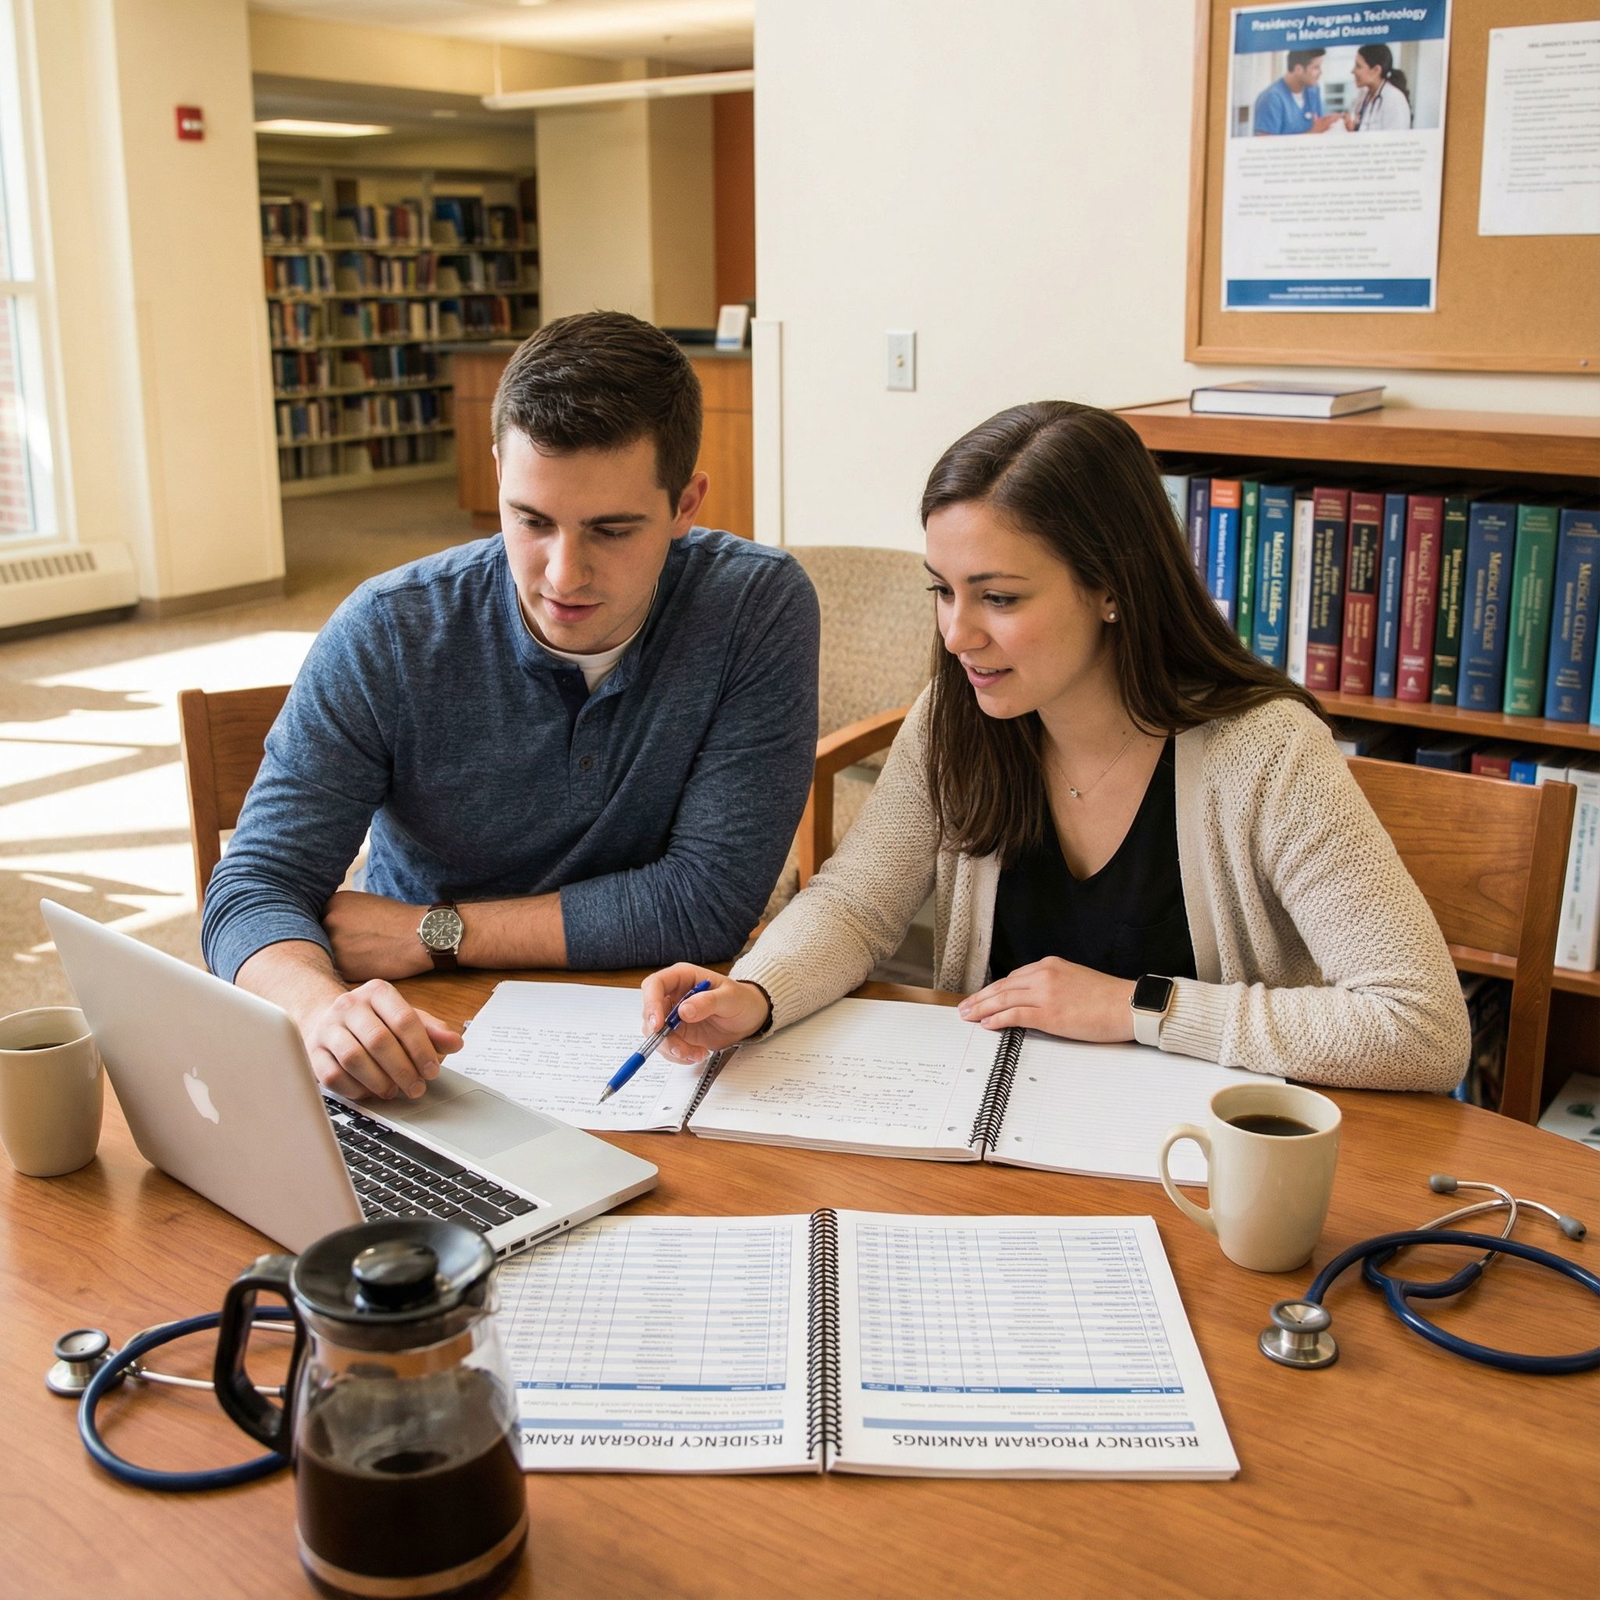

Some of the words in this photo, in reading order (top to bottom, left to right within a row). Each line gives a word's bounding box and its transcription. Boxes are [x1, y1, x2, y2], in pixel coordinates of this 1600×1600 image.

[1251, 17, 1305, 31] Residency
[1307, 13, 1353, 28] Program
[1364, 7, 1427, 22] Technology
[1286, 30, 1297, 42] in
[1299, 26, 1340, 41] Medical
[521, 1433, 575, 1446] RANK
[580, 1434, 674, 1448] PROGRAM
[679, 1434, 783, 1448] RESIDENCY
[892, 1433, 988, 1448] RANKINGS
[994, 1435, 1089, 1449] PROGRAM
[1095, 1435, 1199, 1449] RESIDENCY
